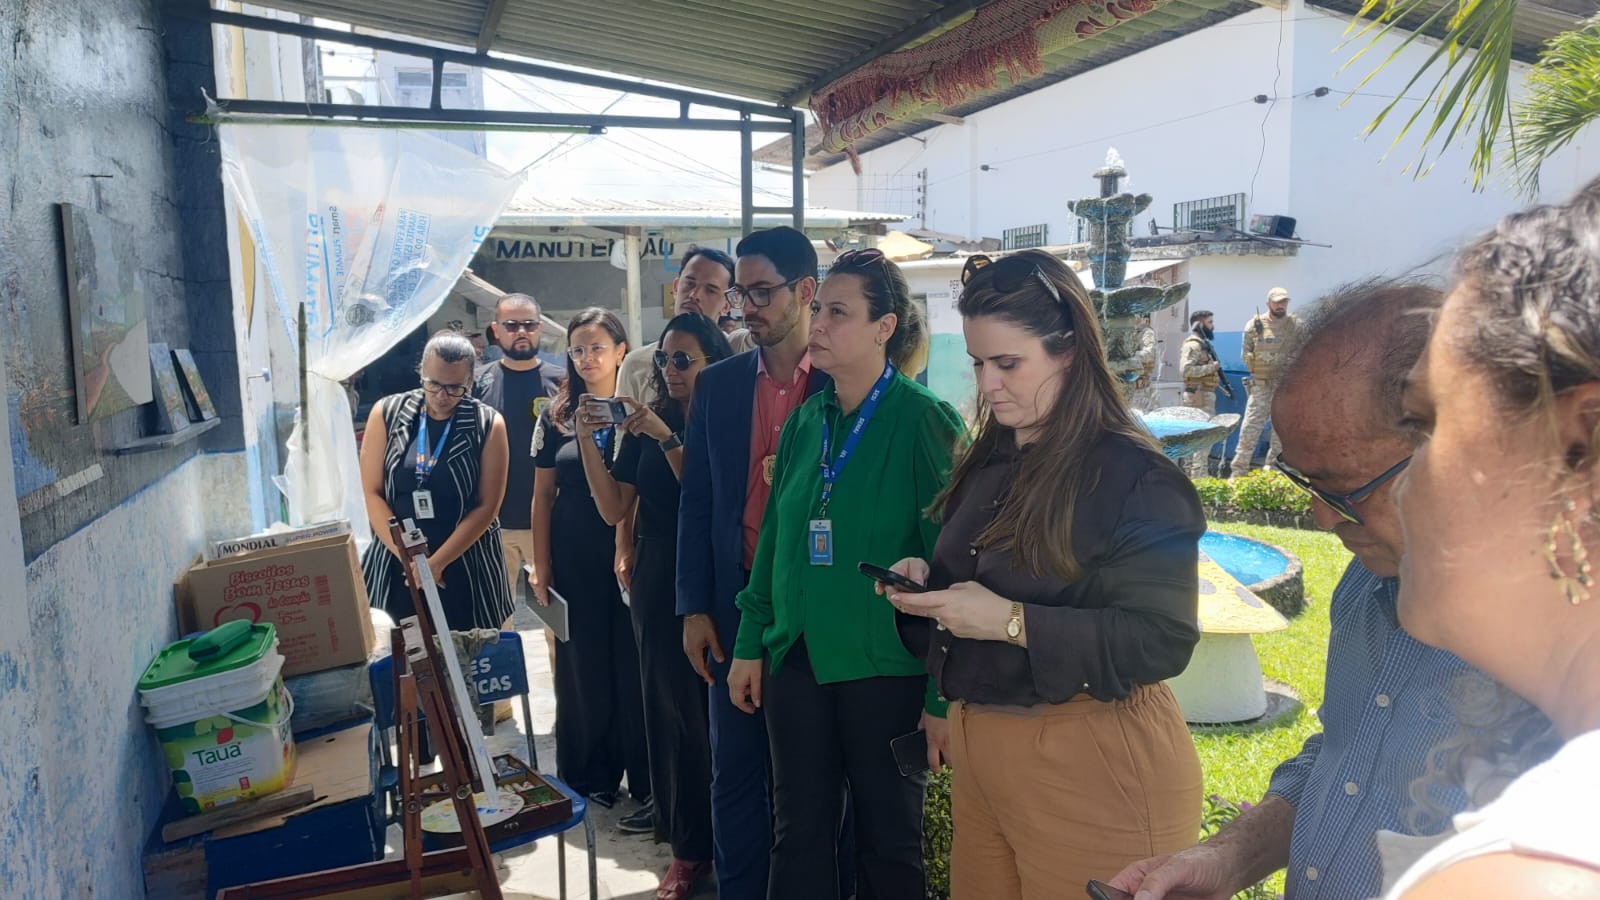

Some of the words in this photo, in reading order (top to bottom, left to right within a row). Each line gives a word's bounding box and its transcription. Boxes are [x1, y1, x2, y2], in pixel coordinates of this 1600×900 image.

[496, 232, 673, 259] MANUTEÃO
[223, 538, 278, 555] MONDIAL
[229, 564, 294, 586] Biscoitos
[224, 584, 263, 603] Bom
[265, 575, 310, 595] Jesus
